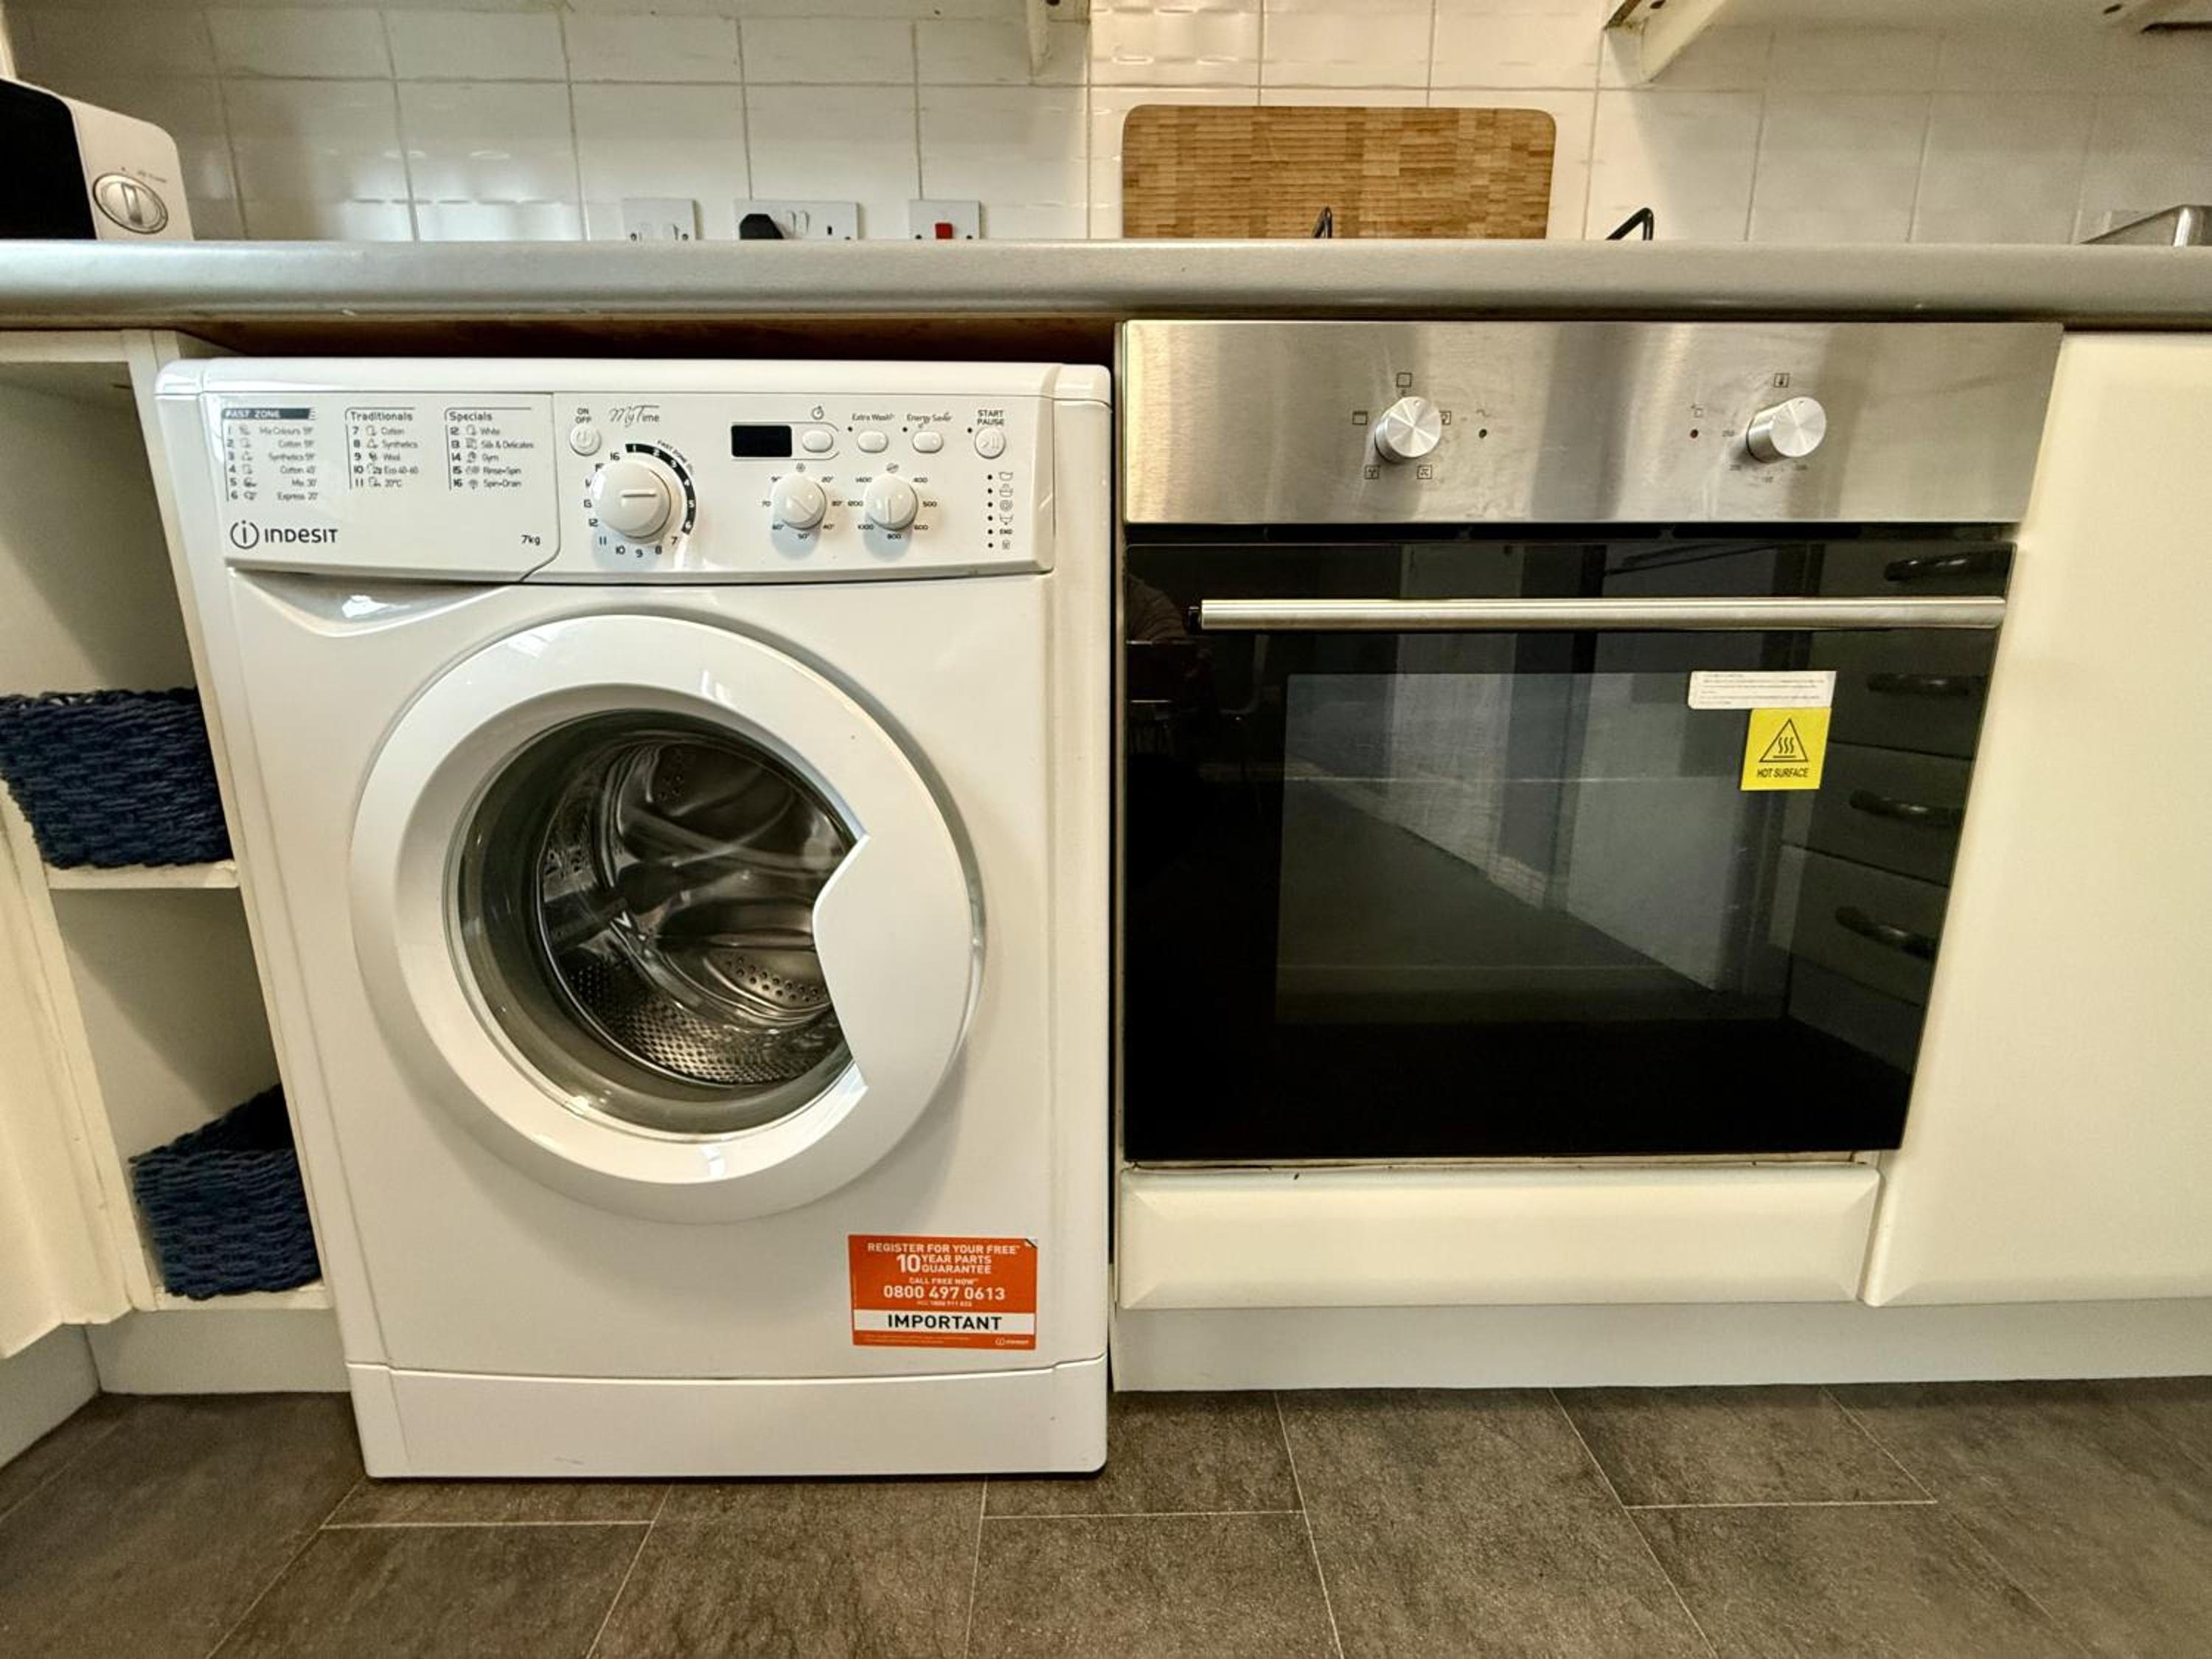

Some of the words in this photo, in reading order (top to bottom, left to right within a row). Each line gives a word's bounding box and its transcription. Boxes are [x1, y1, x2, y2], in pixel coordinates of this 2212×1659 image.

[351, 411, 413, 421] Traditionals
[449, 411, 493, 422] Specials
[609, 405, 660, 428] MyTime
[852, 413, 870, 422] Extra
[977, 409, 1004, 417] START
[906, 414, 931, 425] Energy
[352, 425, 359, 435] 7
[450, 426, 459, 436] 12
[451, 439, 460, 449] 13
[355, 452, 361, 461] 9
[451, 452, 461, 462] 14
[610, 452, 621, 462] 16
[652, 448, 661, 457] 2
[669, 459, 678, 469] 3
[354, 465, 364, 474] 10
[453, 465, 462, 474] 15
[355, 478, 364, 487] 11
[453, 478, 463, 487] 16
[684, 479, 690, 487] 4
[231, 490, 238, 500] 6
[689, 499, 695, 509] 5
[588, 518, 599, 527] 12
[685, 521, 692, 530] 6
[521, 535, 540, 546] 7kg
[599, 536, 607, 546] 11
[670, 536, 678, 546] 7
[616, 546, 625, 554] 10
[636, 549, 643, 558] 9
[655, 545, 662, 554] 8
[1756, 768, 1773, 778] HOT
[1774, 768, 1809, 778] SURFACE
[867, 1242, 925, 1253] REGISTER
[927, 1243, 950, 1253] FOR
[952, 1244, 984, 1254] YOUR
[896, 1253, 922, 1274] 10
[921, 1254, 952, 1263] YEAR
[954, 1255, 992, 1265] PARTS
[921, 1265, 992, 1274] GUARANTEE
[908, 1276, 929, 1285] CALL
[931, 1277, 953, 1285] FREE
[884, 1285, 924, 1298] 0800
[928, 1286, 959, 1299] 497
[964, 1287, 1005, 1300] 0613
[888, 1314, 1002, 1330] IMPORTANT
